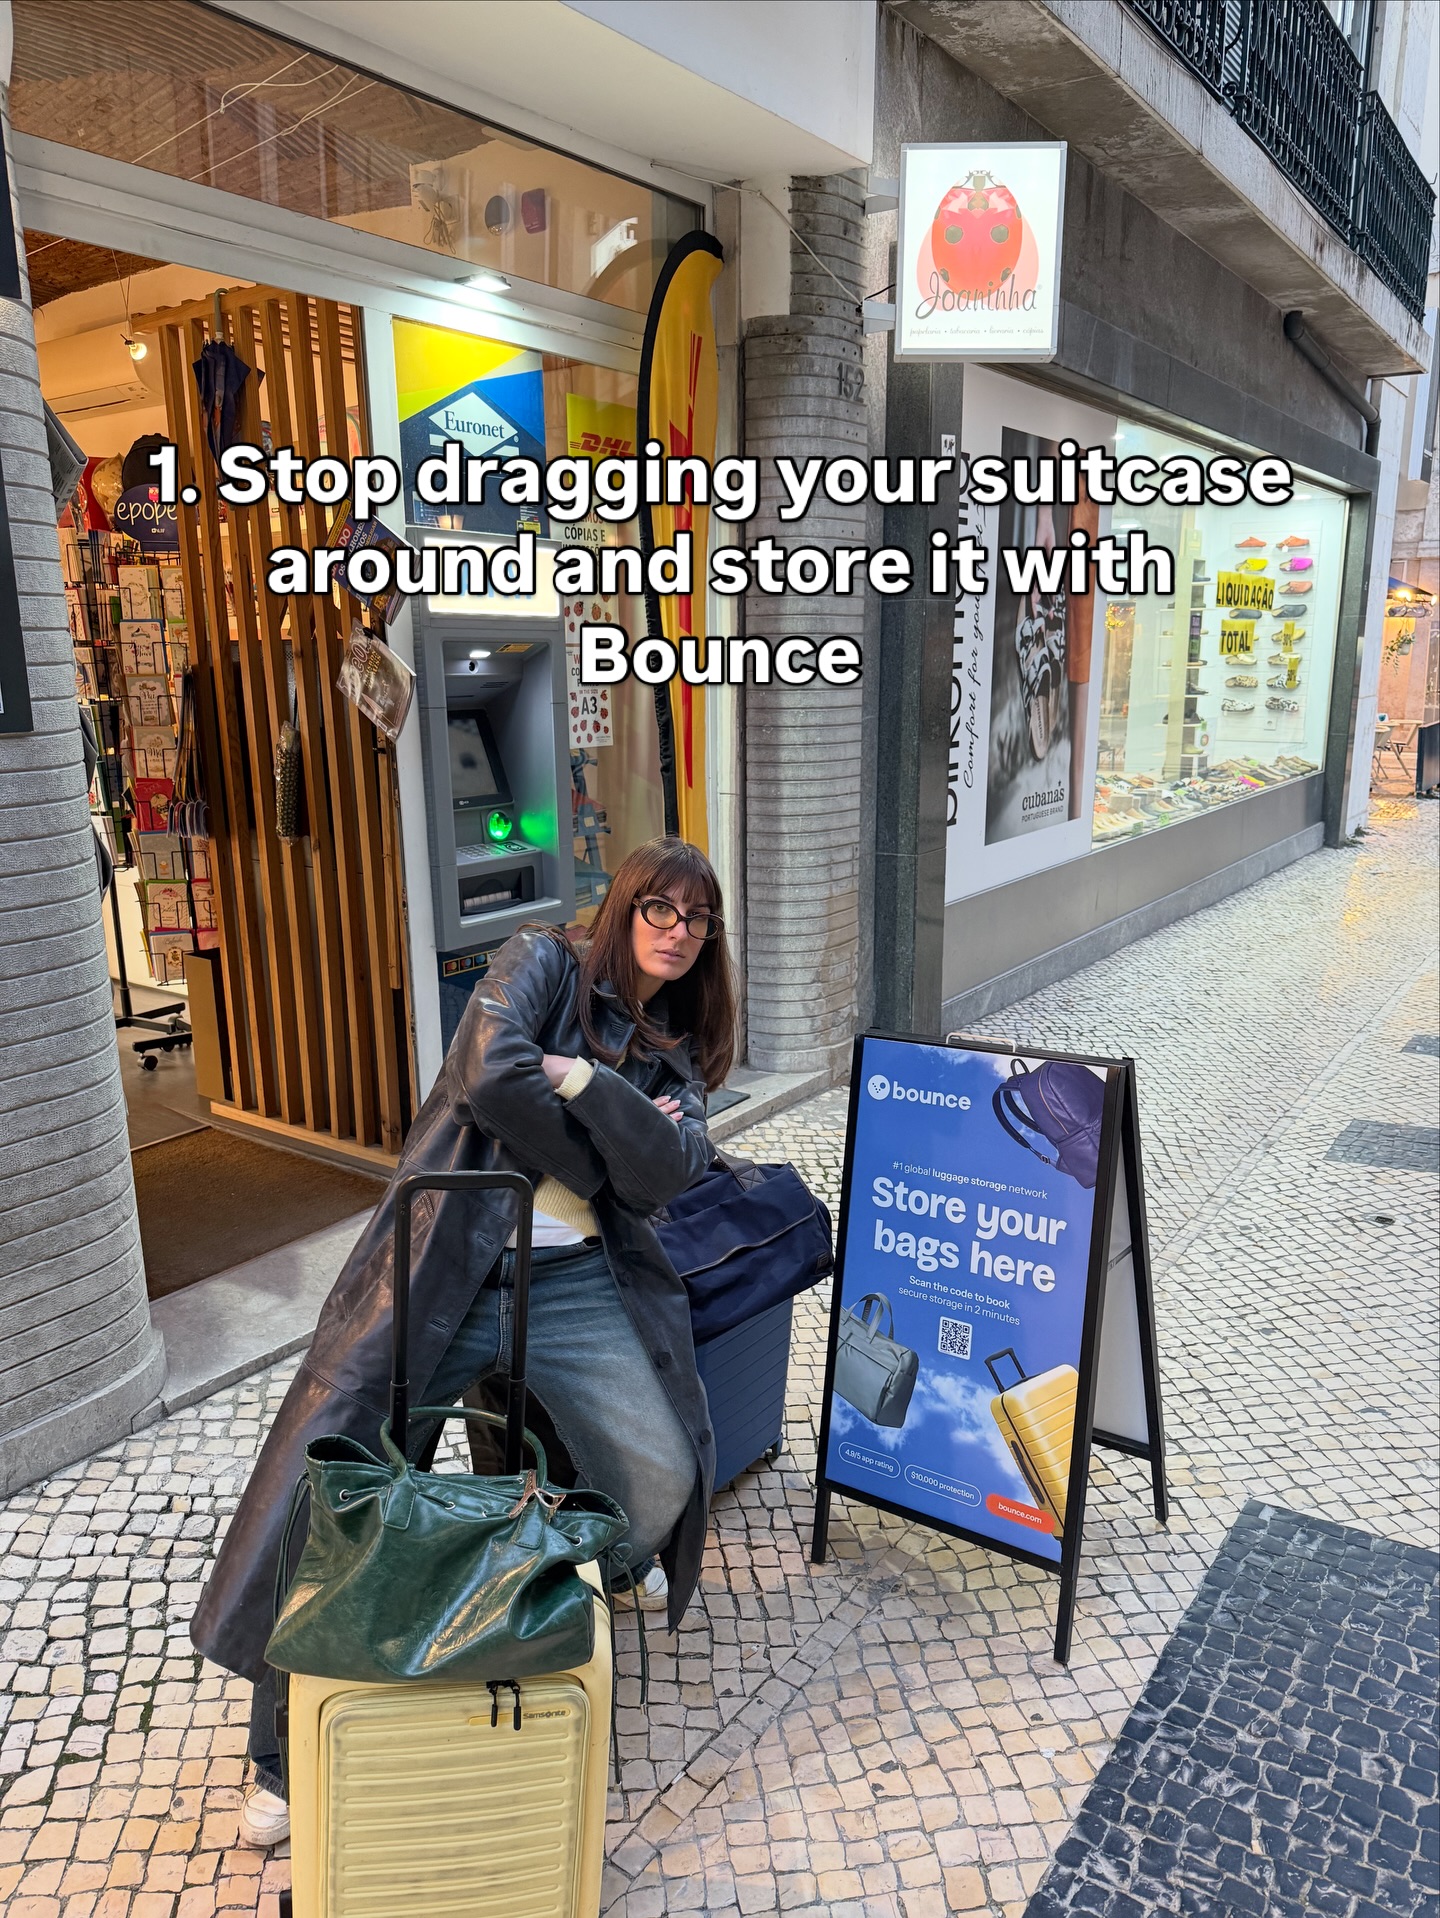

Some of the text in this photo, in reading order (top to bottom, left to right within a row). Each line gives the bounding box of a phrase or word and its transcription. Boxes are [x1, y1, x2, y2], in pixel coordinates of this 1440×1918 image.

[915, 271, 1038, 319] Joaninha
[443, 410, 505, 439] Euronet
[580, 431, 635, 457] DHL
[564, 523, 606, 542] CÓPIAS E
[1216, 583, 1275, 610] LIQUIDAÇÃO
[973, 588, 984, 642] you
[1220, 630, 1251, 653] TOTAL
[967, 647, 981, 687] for
[581, 696, 598, 715] A3
[964, 691, 979, 788] Comfort
[1022, 787, 1065, 811] cubanas
[1021, 805, 1064, 823] PORTUGUESE BRAND
[892, 1081, 972, 1111] bounce
[892, 1161, 1048, 1200] #1 global luggage storage network
[872, 1176, 1067, 1246] Store your
[873, 1218, 1056, 1293] bags here
[898, 1287, 1021, 1326] secure storage in 2 minutes
[909, 1275, 1011, 1310] Scan the code to book
[844, 1448, 894, 1473] 4.9/5 app rating
[910, 1470, 975, 1501] $10,000 protection
[997, 1501, 1043, 1525] bounce.com
[523, 1710, 566, 1720] Samsonite
